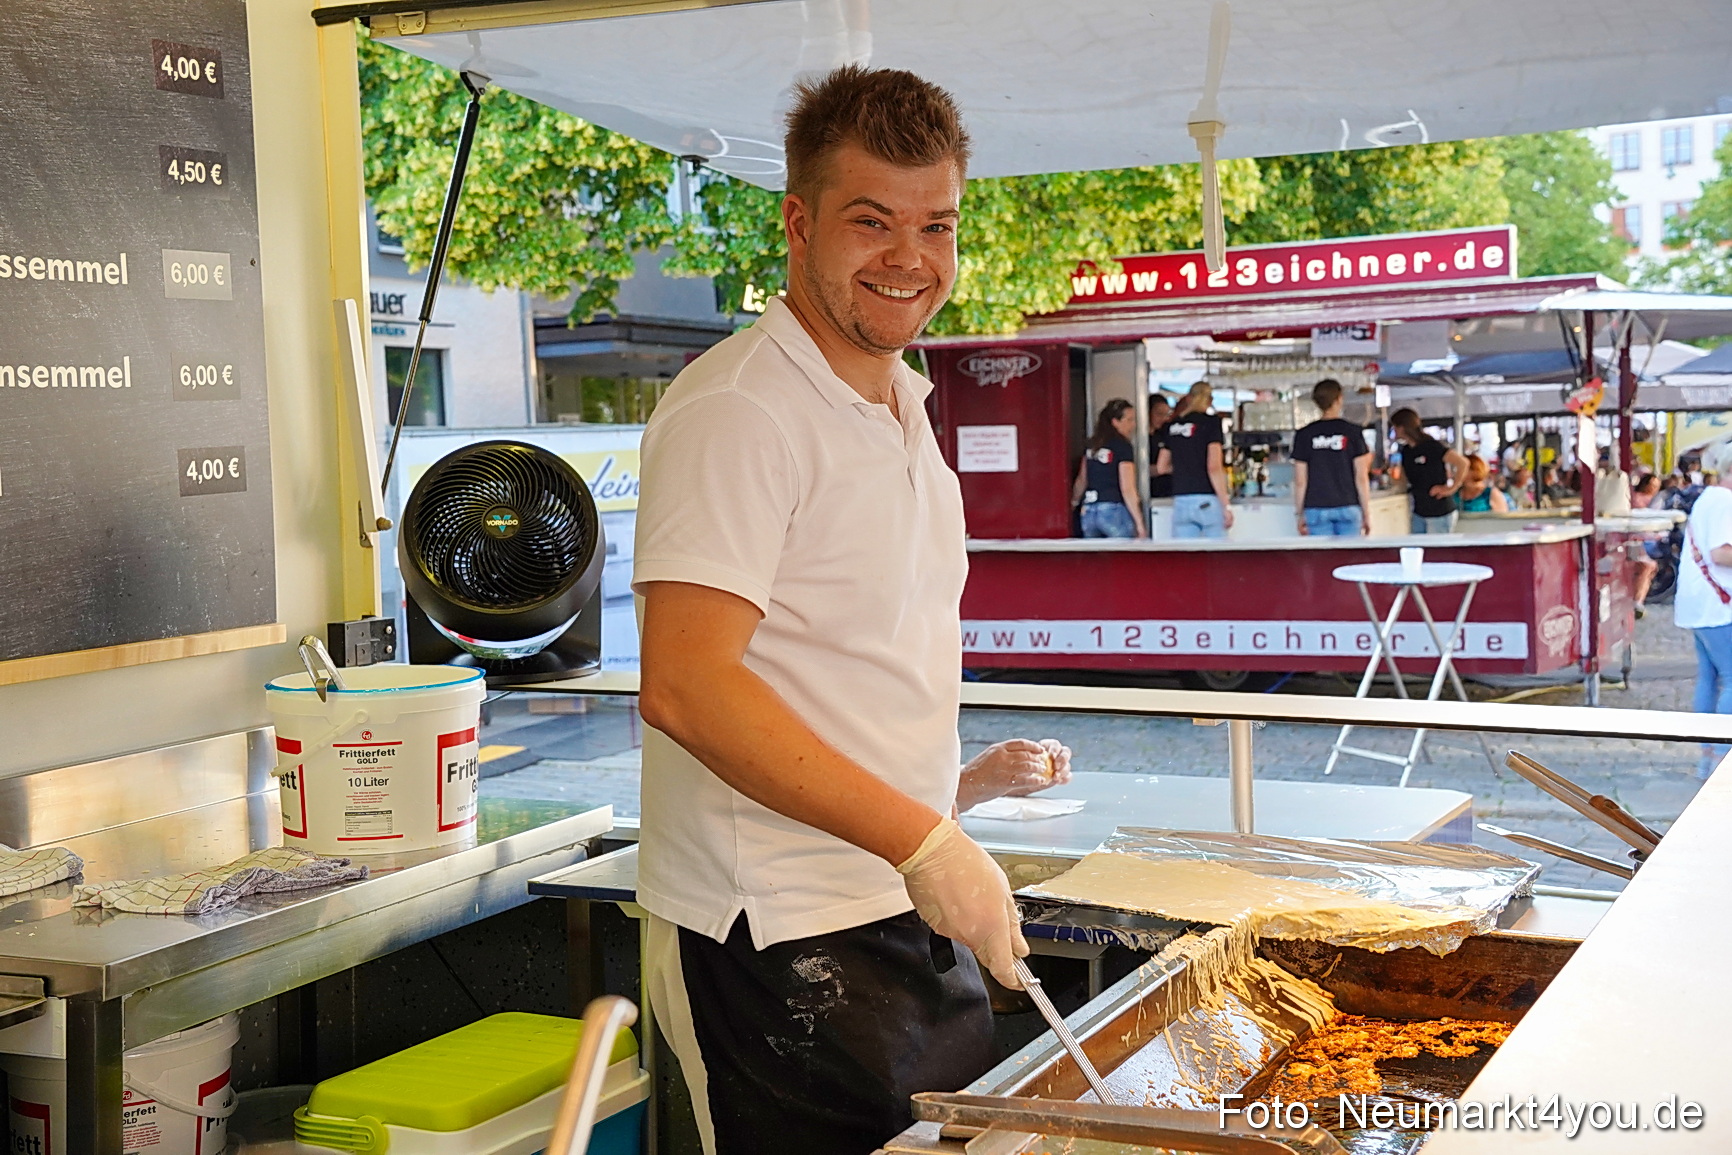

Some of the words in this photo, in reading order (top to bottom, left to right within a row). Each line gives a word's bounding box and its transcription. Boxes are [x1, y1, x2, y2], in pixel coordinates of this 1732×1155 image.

[161, 55, 200, 81] 4,00
[204, 61, 217, 83] €
[168, 160, 206, 185] 4,50
[210, 164, 222, 185] €
[0, 253, 129, 285] ssemmel
[170, 262, 209, 288] 6,00
[213, 265, 225, 286] €
[1071, 241, 1505, 297] www.123eichner.de
[0, 356, 132, 388] nsemmel
[180, 364, 218, 389] 6,00
[221, 365, 234, 386] €
[186, 458, 224, 483] 4,00
[228, 457, 240, 478] €
[486, 519, 519, 527] VORNADO
[962, 625, 1502, 652] www.123eichner.de
[339, 748, 396, 759] Frittierfett
[356, 757, 379, 766] GOLD
[347, 777, 362, 788] 10
[363, 776, 390, 788] Liter
